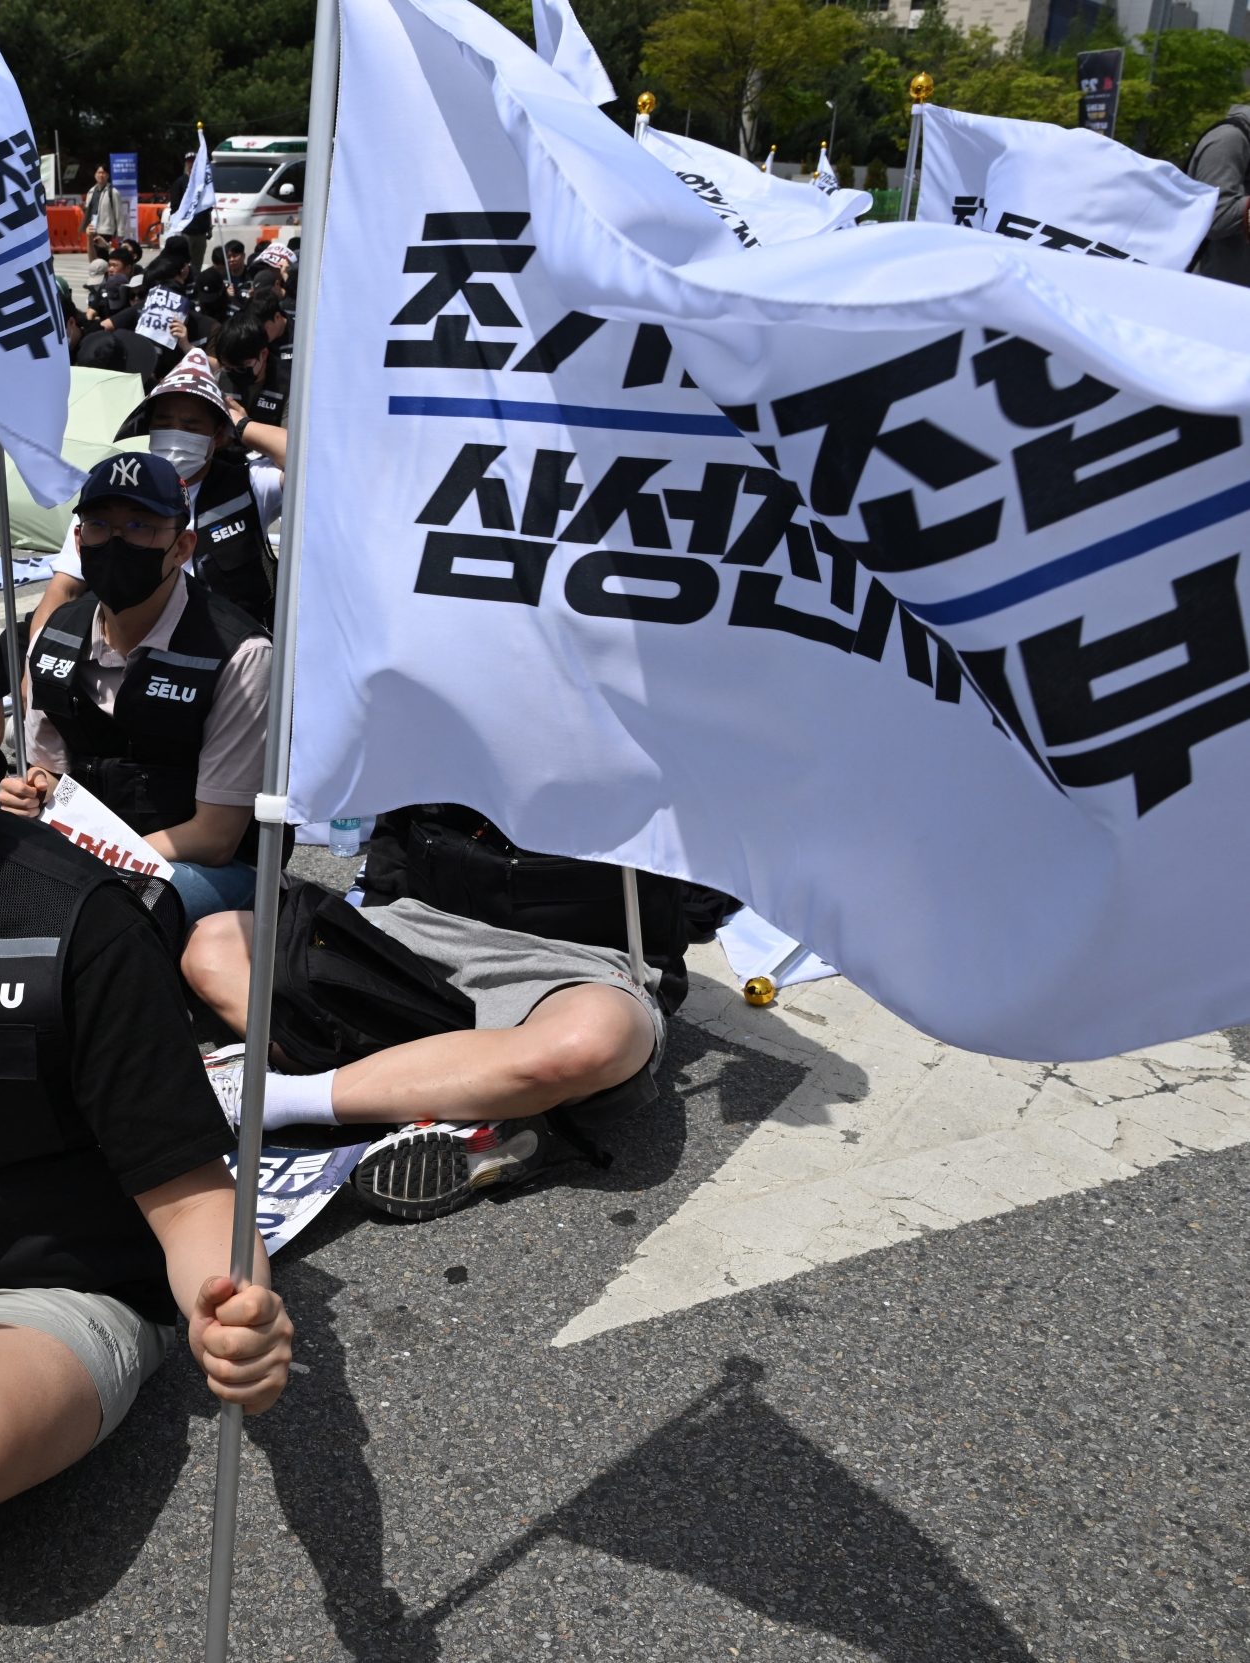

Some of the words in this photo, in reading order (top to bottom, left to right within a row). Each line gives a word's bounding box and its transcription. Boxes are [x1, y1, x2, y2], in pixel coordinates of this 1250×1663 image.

[256, 399, 276, 411] SELU
[108, 457, 142, 487] NY
[210, 520, 247, 543] SELU
[36, 653, 75, 678] 투쟁
[145, 680, 197, 703] SELU
